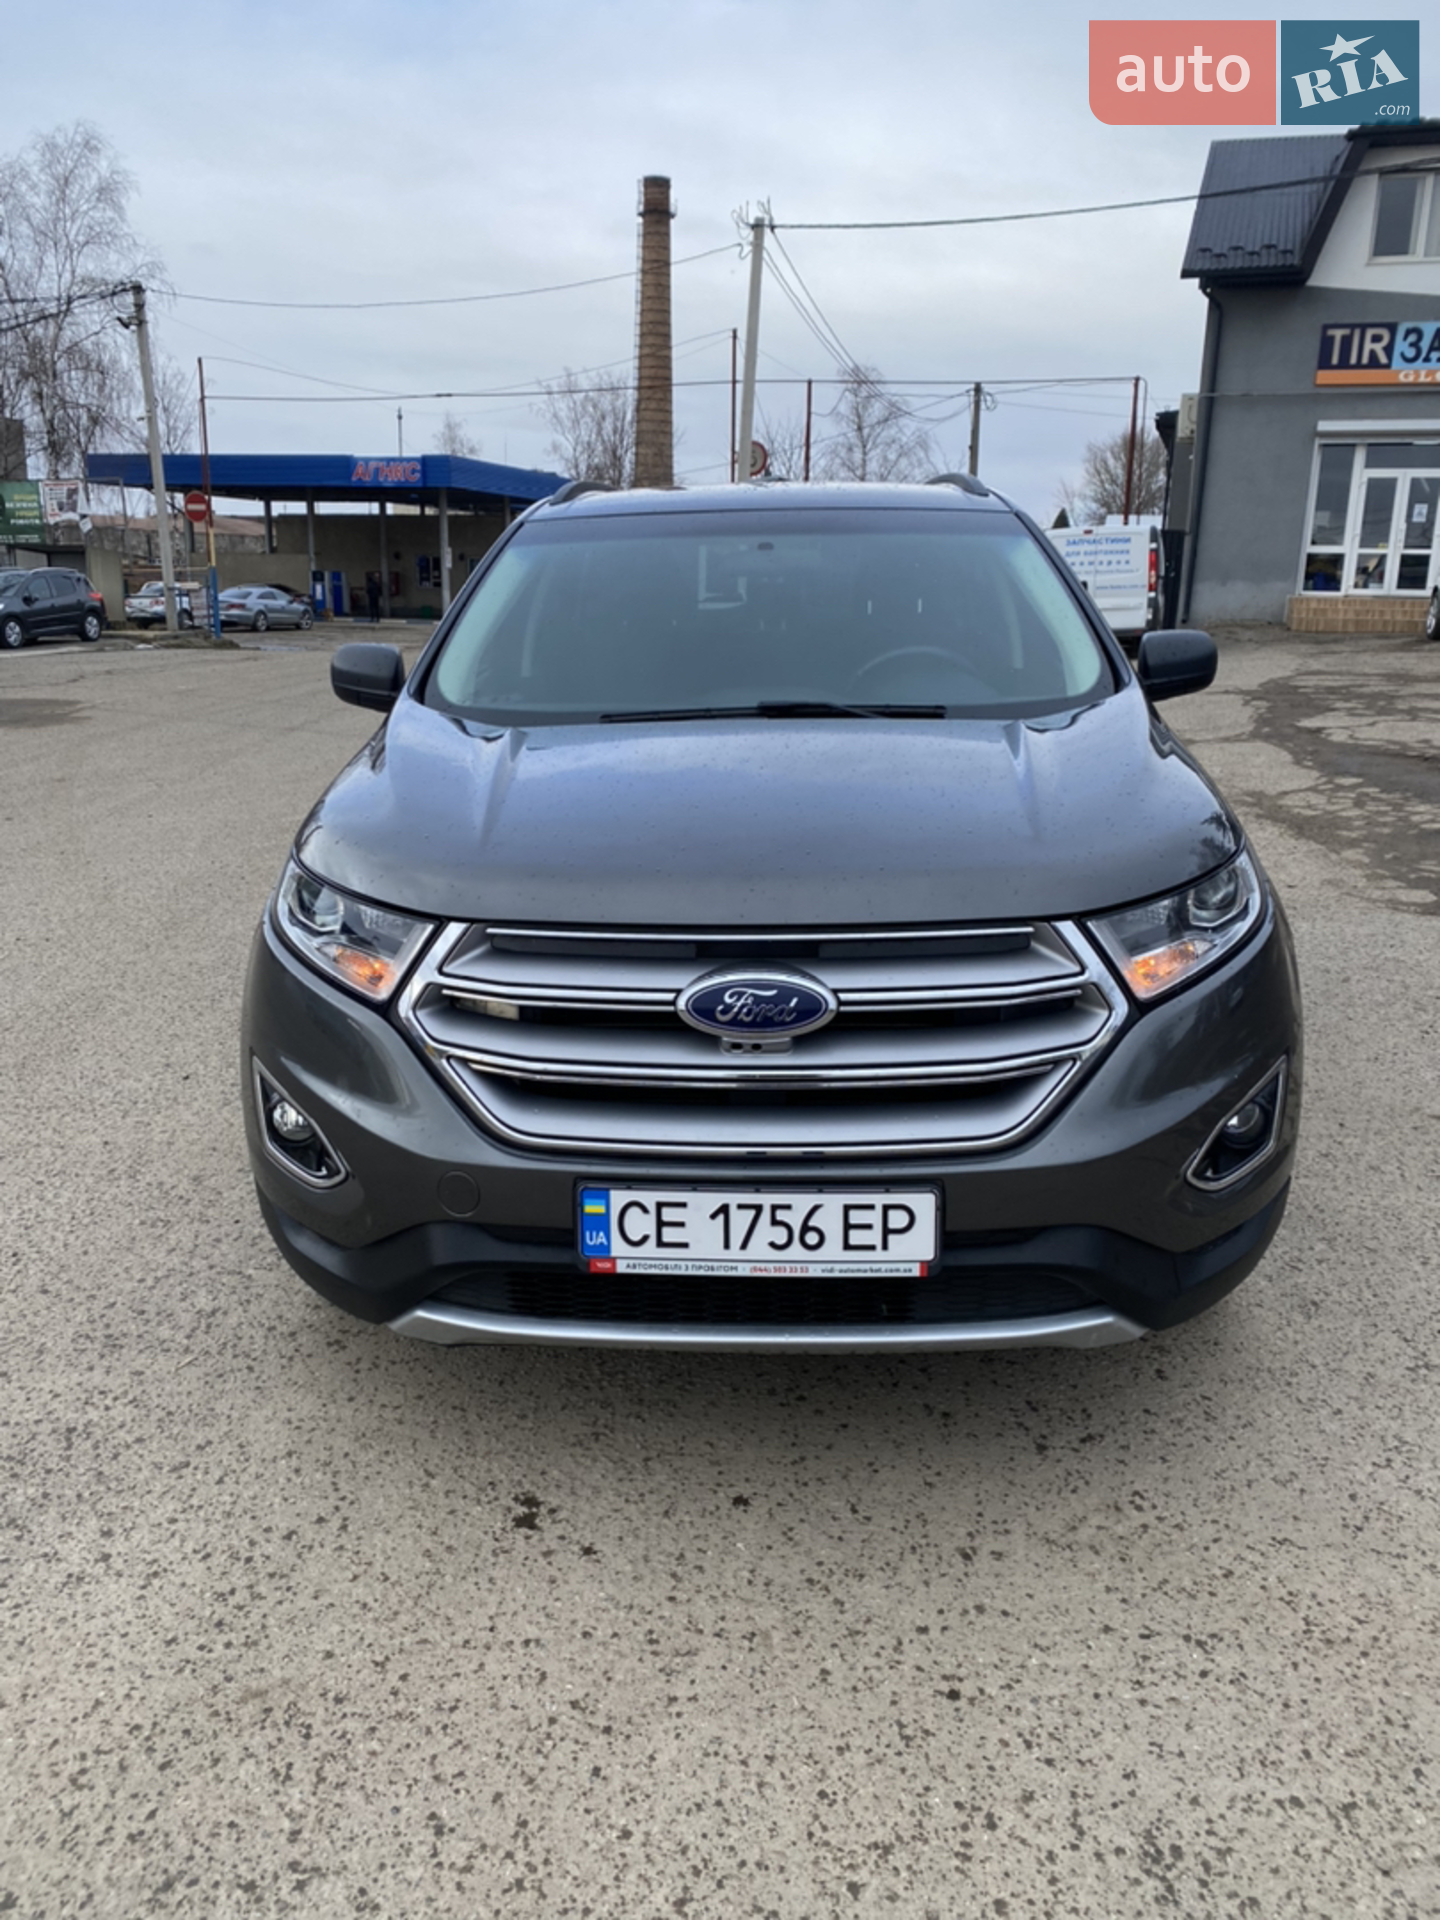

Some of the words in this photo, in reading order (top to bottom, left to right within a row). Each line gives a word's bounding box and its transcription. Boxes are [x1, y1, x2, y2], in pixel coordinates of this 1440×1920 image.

[1326, 327, 1392, 366] TIR
[351, 461, 421, 483] АГНКС
[1066, 537, 1131, 546] ЗАПЧАСТИНИ
[715, 987, 799, 1022] Ford
[617, 1200, 689, 1249] CE
[709, 1203, 826, 1252] 1756
[842, 1204, 917, 1252] EP
[586, 1231, 608, 1245] UA
[625, 1262, 682, 1271] АВТОМОБІЛІ
[691, 1265, 739, 1273] ПРОБІГОМ
